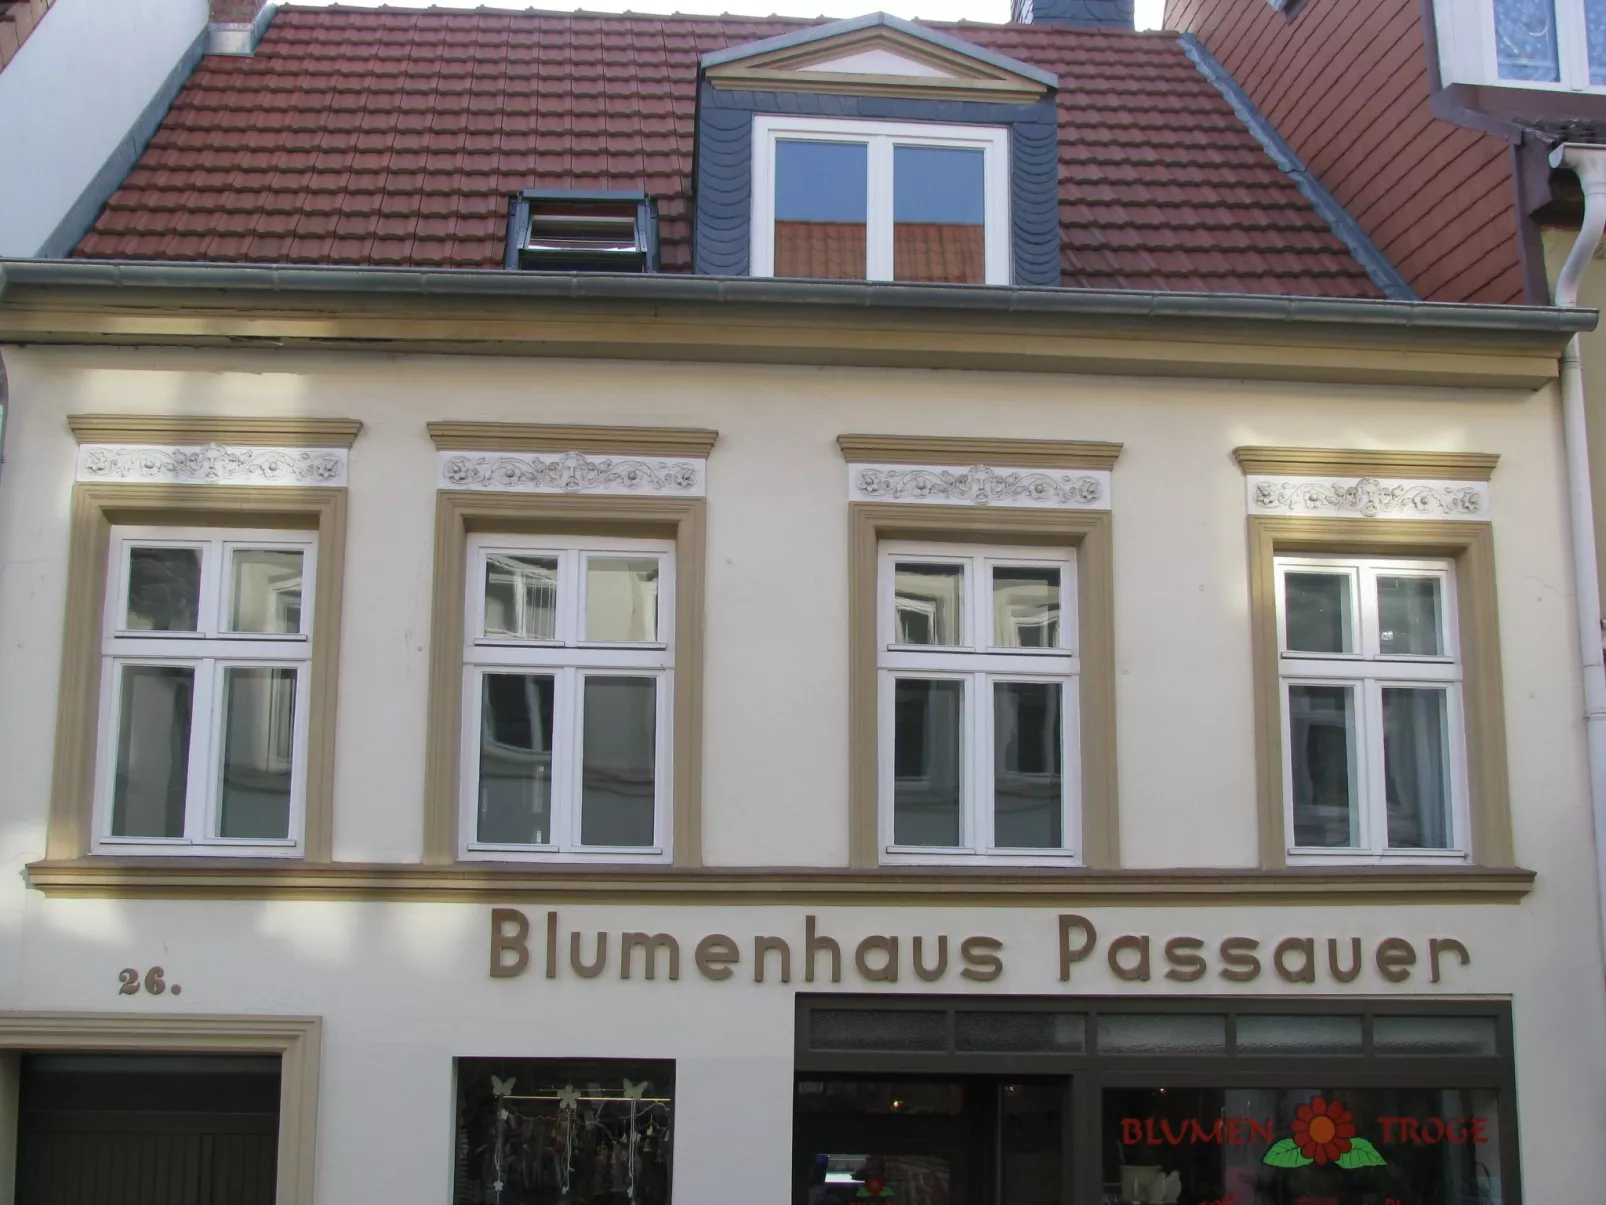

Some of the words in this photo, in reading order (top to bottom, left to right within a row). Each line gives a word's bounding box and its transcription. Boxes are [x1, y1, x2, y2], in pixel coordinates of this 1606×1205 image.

[490, 908, 1003, 982] Blumenhaus
[1058, 914, 1470, 983] Passauer
[1120, 1117, 1275, 1145] BLUMEN
[1376, 1117, 1491, 1144] TROGE
